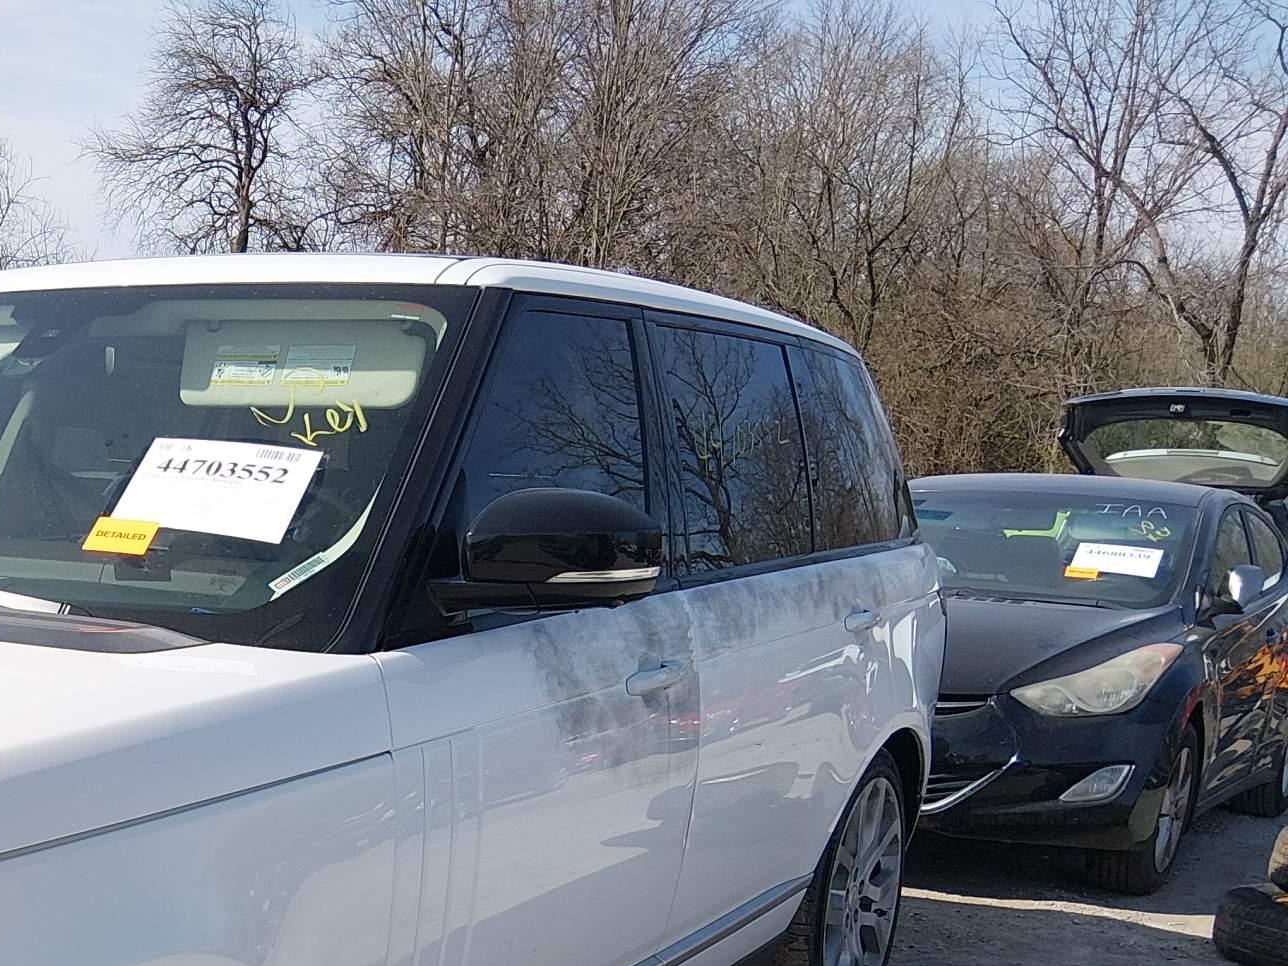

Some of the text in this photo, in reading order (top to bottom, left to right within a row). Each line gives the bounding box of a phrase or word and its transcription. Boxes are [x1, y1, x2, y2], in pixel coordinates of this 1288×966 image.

[157, 457, 289, 484] 44703552
[1095, 503, 1168, 520] IAA
[95, 530, 147, 541] DETAILED
